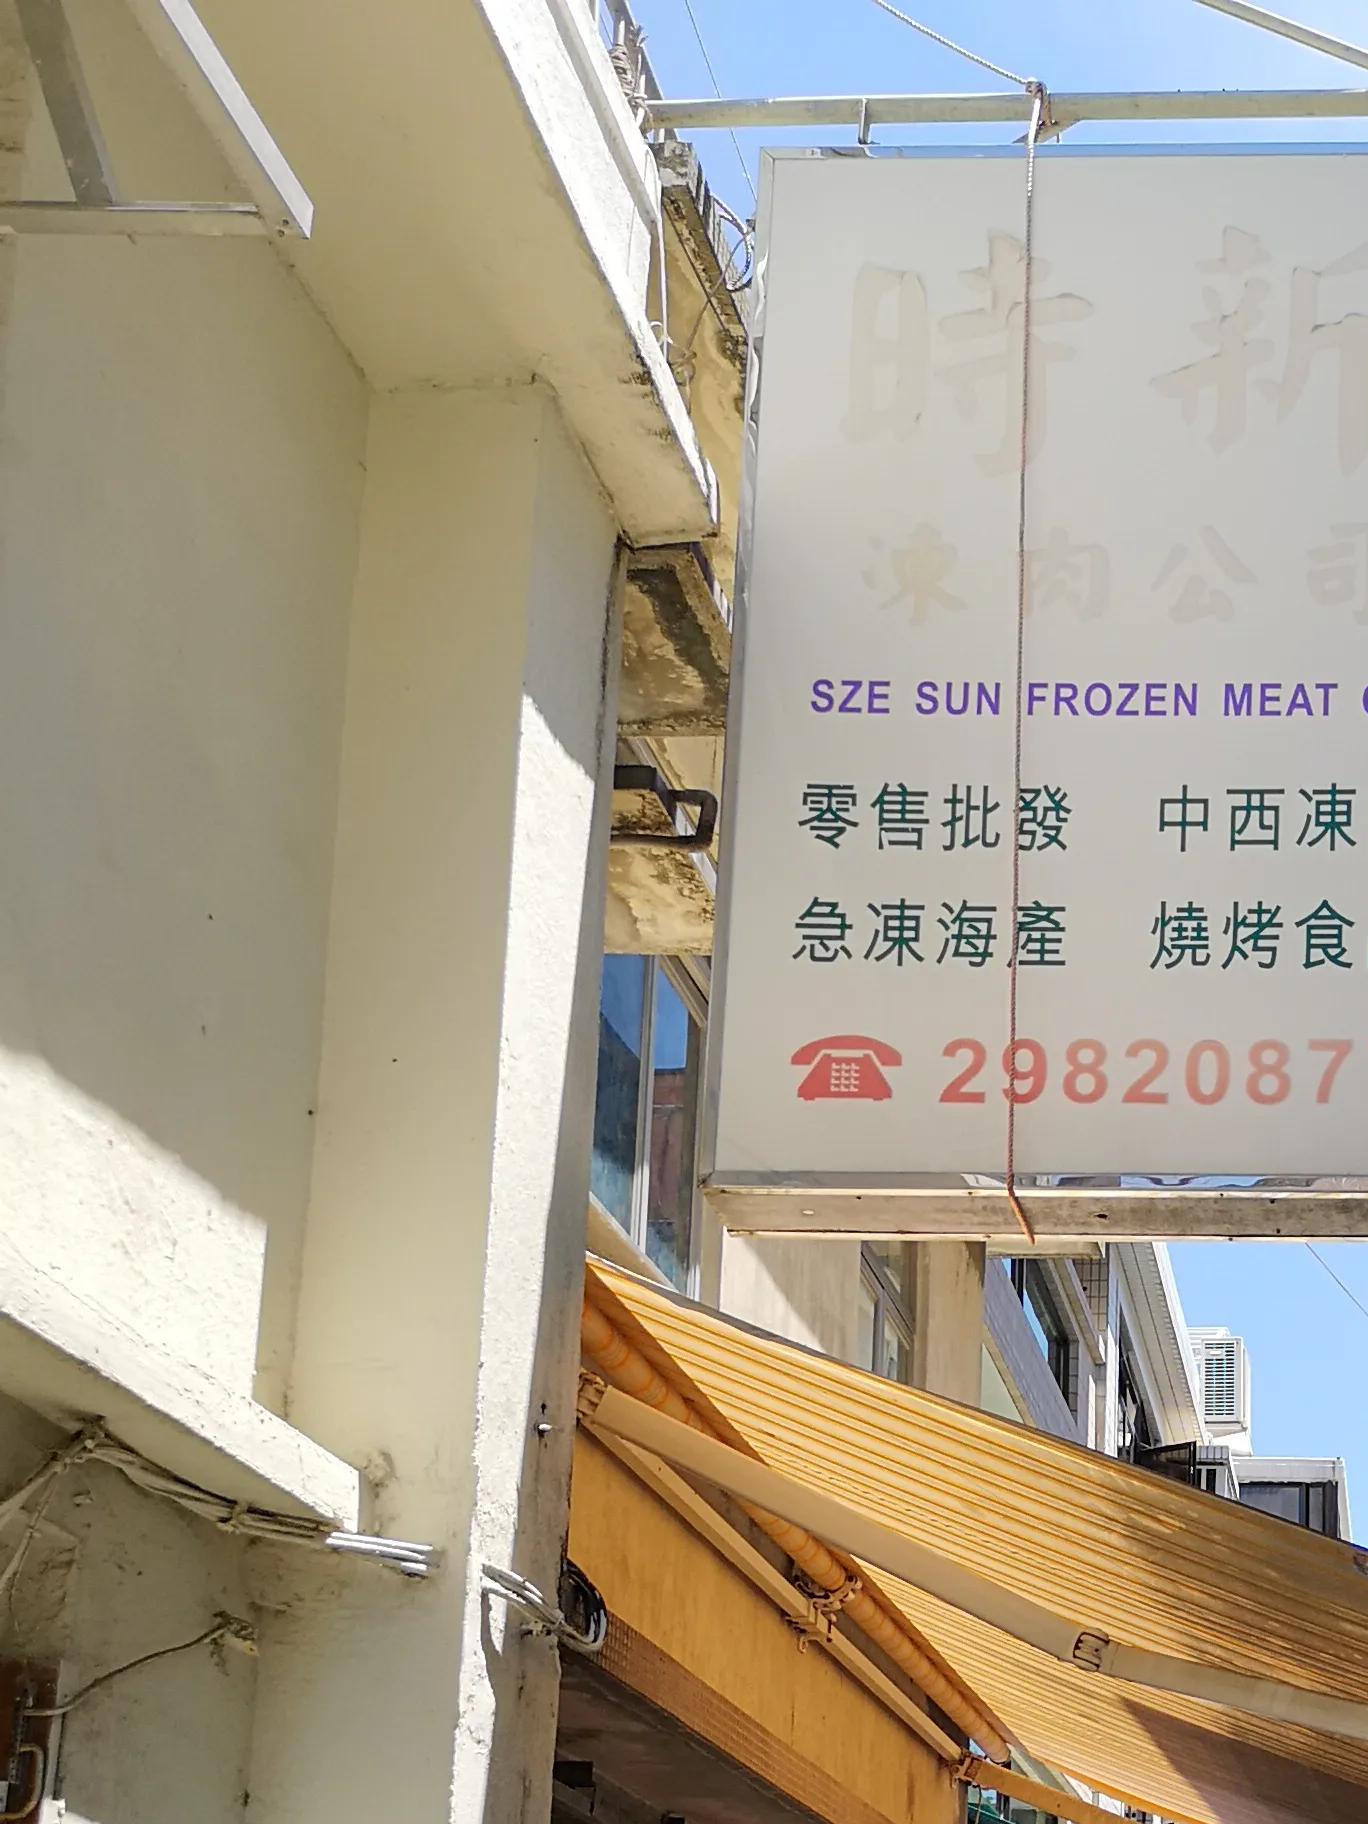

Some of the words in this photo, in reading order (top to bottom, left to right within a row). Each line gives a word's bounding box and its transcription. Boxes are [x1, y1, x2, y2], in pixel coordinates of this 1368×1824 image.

[810, 679, 892, 716] SZE
[914, 682, 1001, 717] SUN
[1026, 682, 1199, 717] FROZEN
[1222, 682, 1339, 717] MEAT
[797, 781, 1073, 853] 零售批發
[791, 895, 1067, 971] 急凍海產
